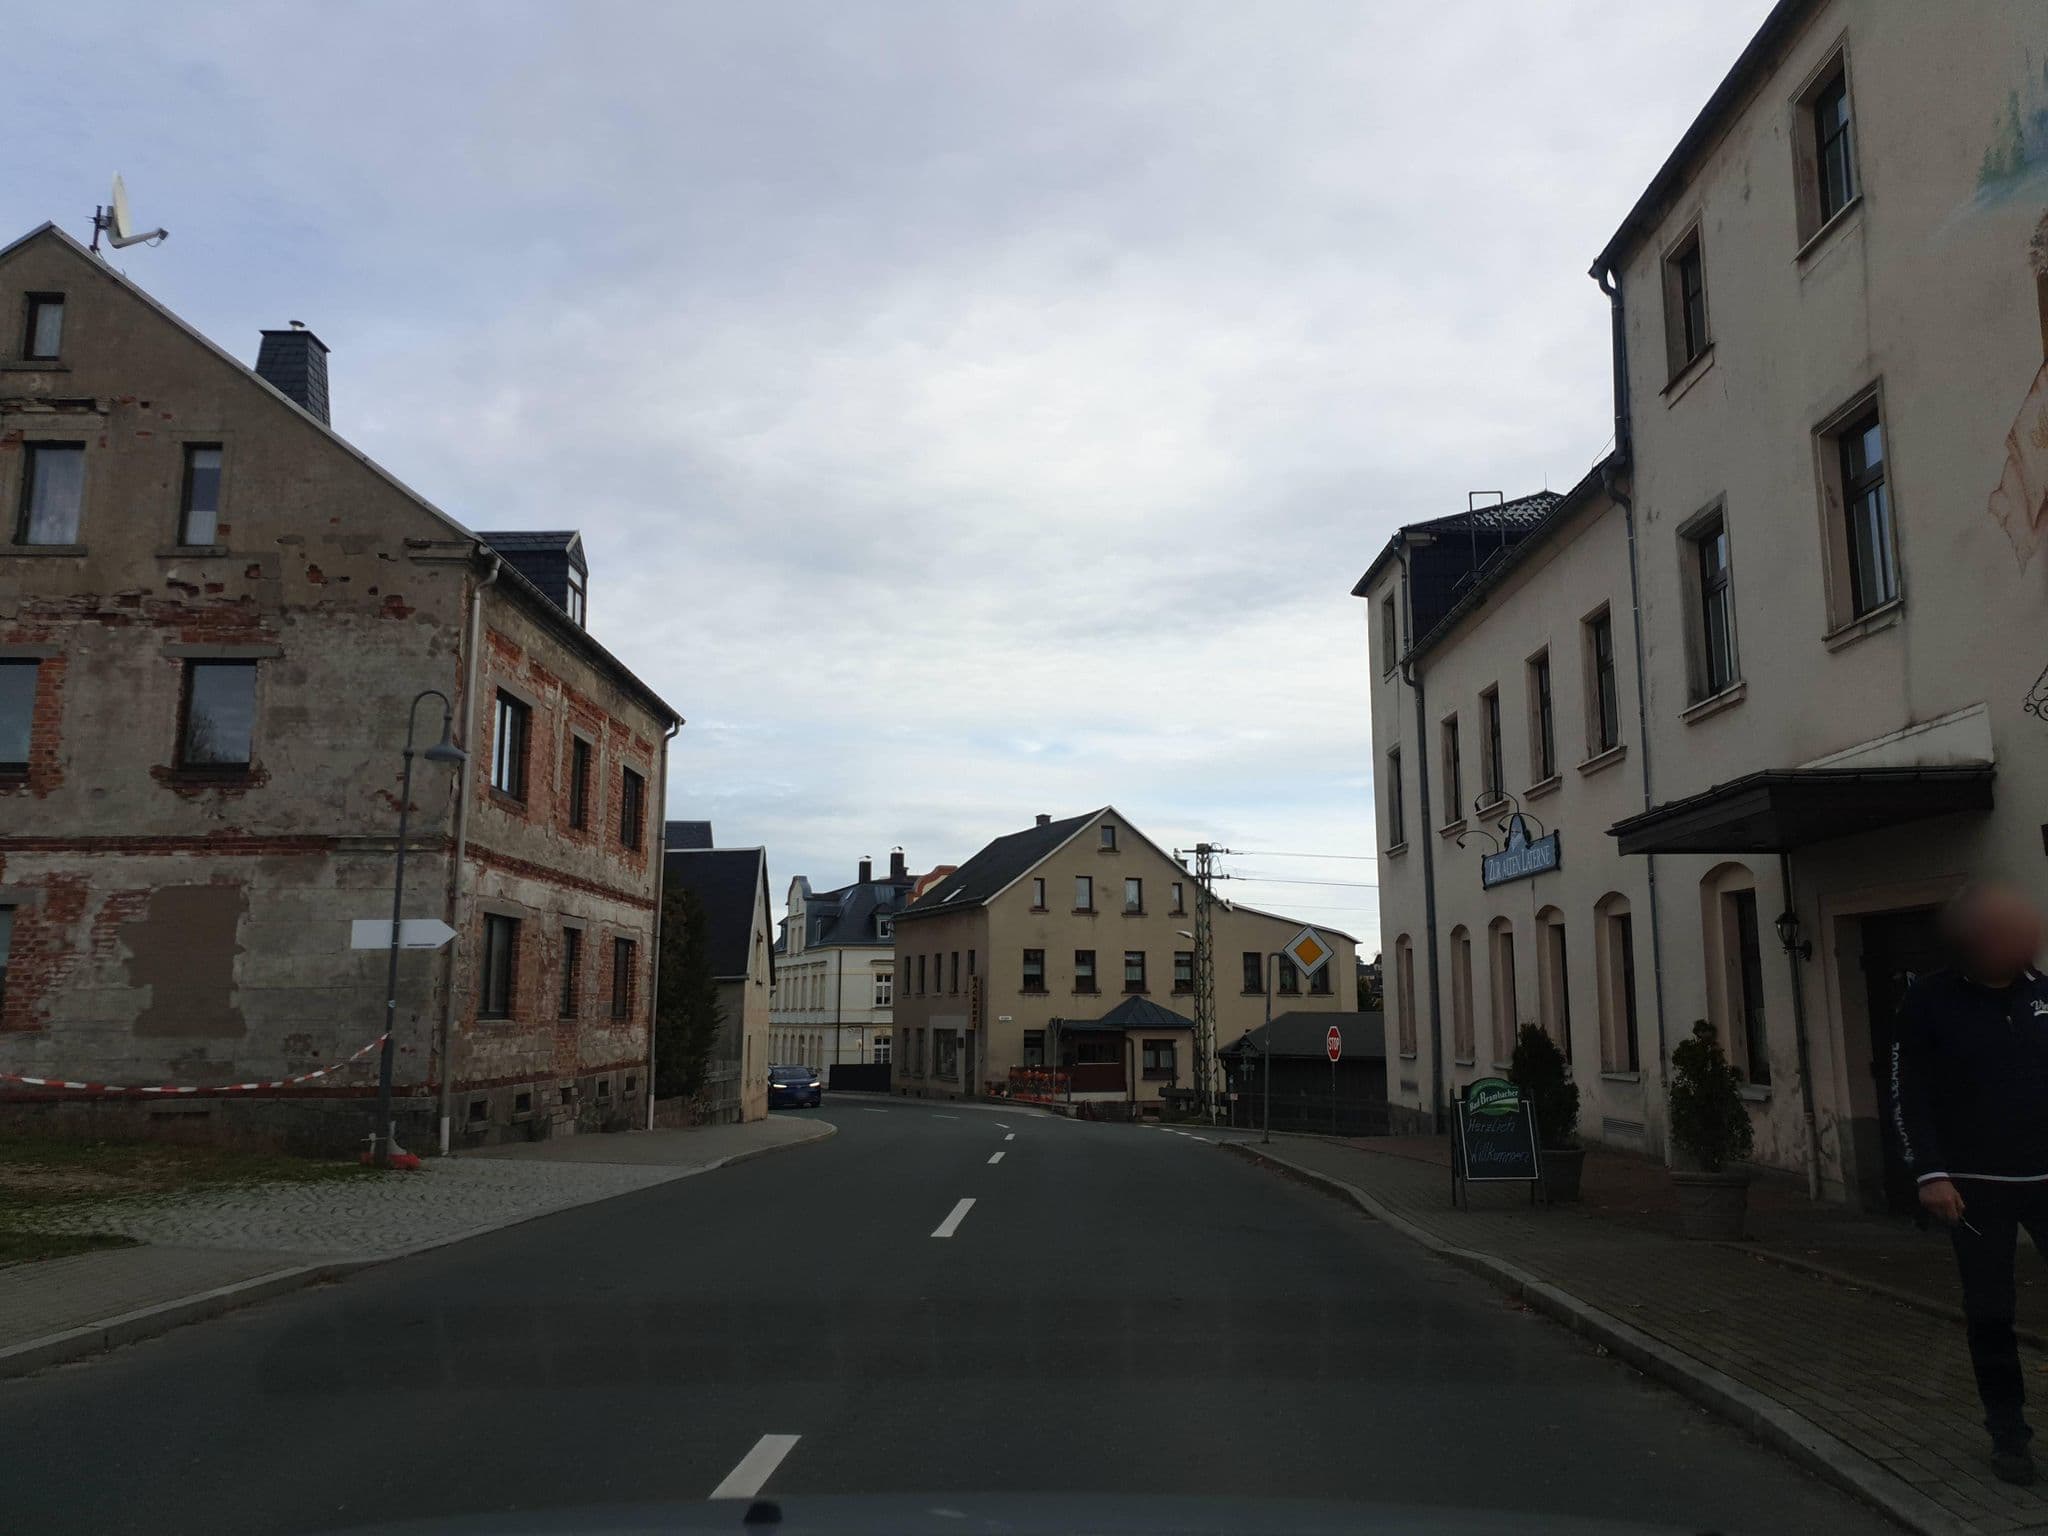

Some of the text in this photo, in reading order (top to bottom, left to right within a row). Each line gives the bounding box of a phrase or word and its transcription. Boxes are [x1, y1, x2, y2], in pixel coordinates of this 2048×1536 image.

[1328, 1036, 1341, 1051] STOP
[1469, 1089, 1519, 1111] Bad Brambacher
